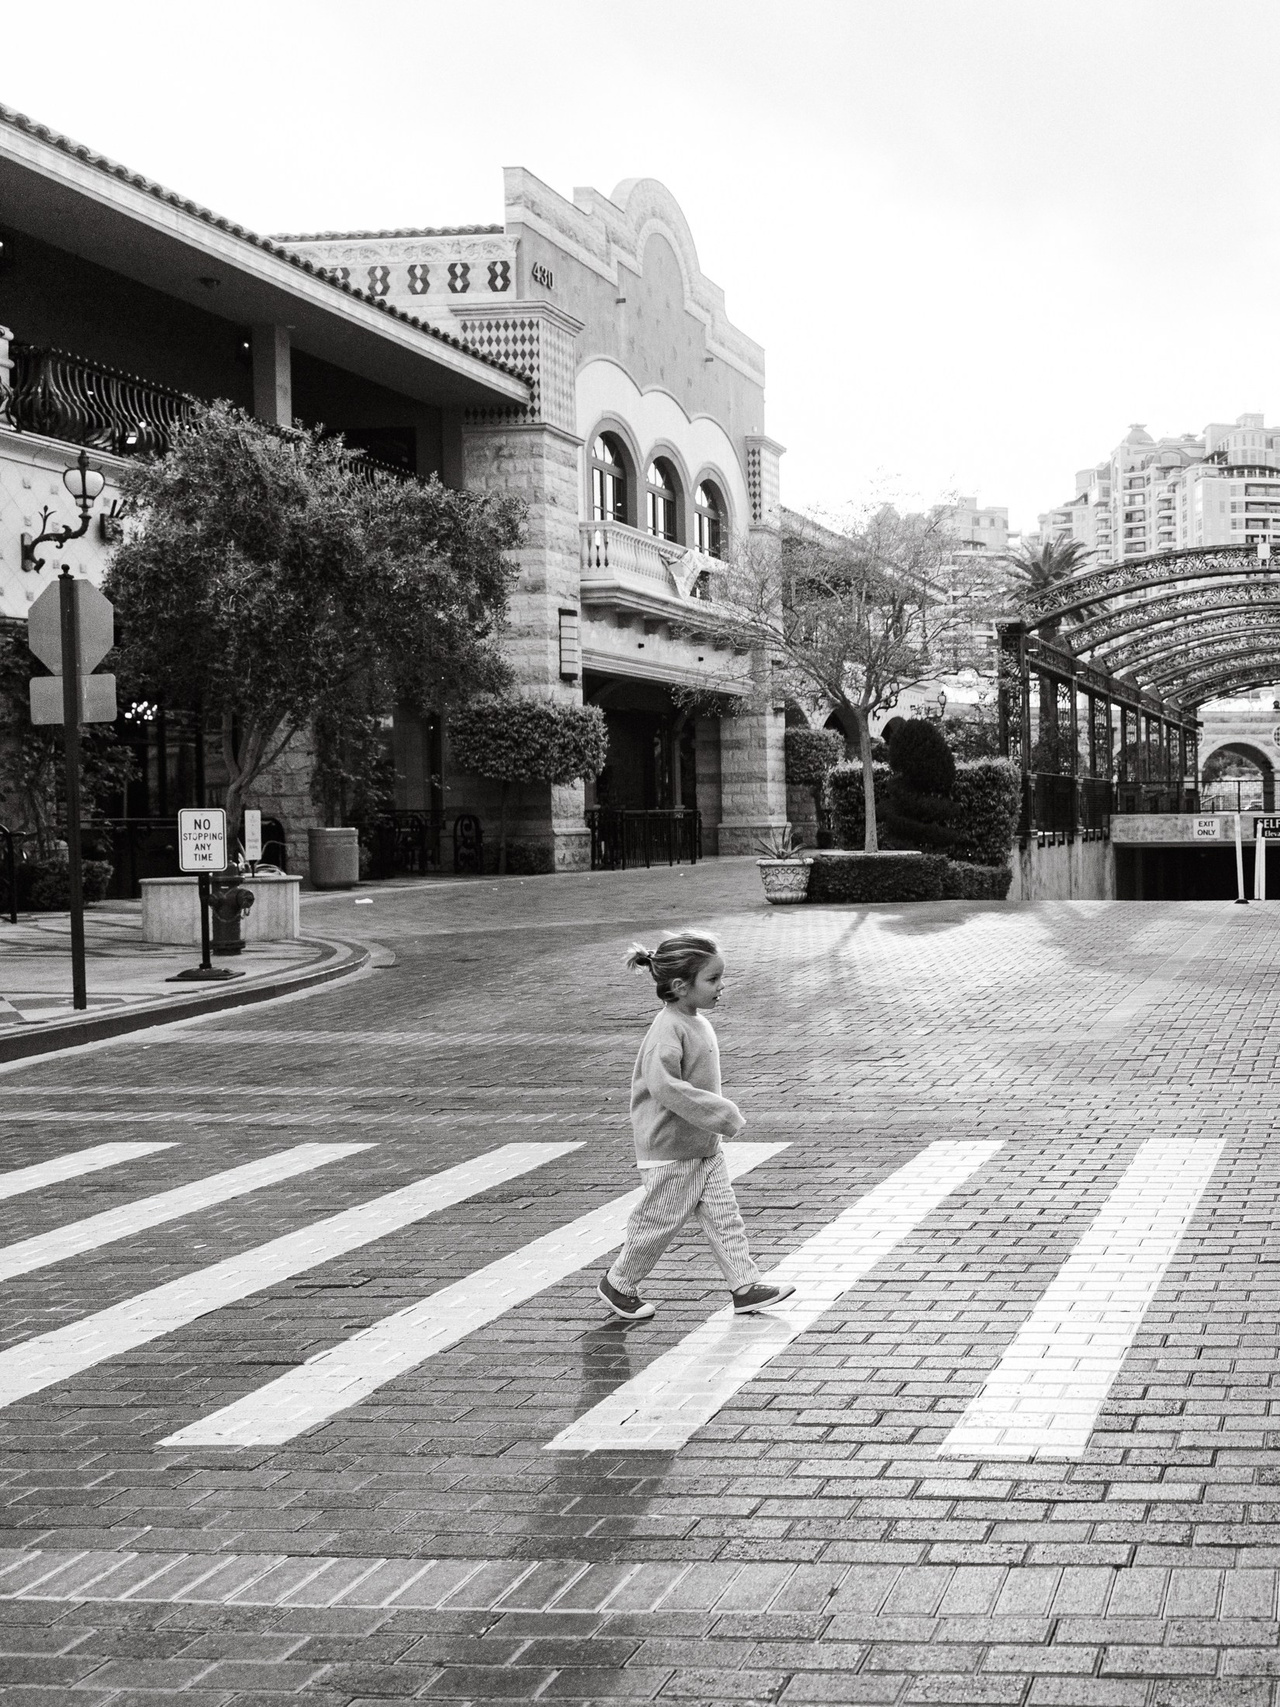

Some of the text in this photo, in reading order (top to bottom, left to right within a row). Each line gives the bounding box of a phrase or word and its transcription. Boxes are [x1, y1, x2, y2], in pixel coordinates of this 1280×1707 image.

[532, 261, 555, 290] 430
[194, 818, 211, 830] NO
[1198, 820, 1214, 828] EXIT
[183, 832, 223, 841] STOPPING
[1197, 828, 1216, 836] ONLY
[194, 843, 212, 851] ANY
[193, 853, 213, 862] TIME
